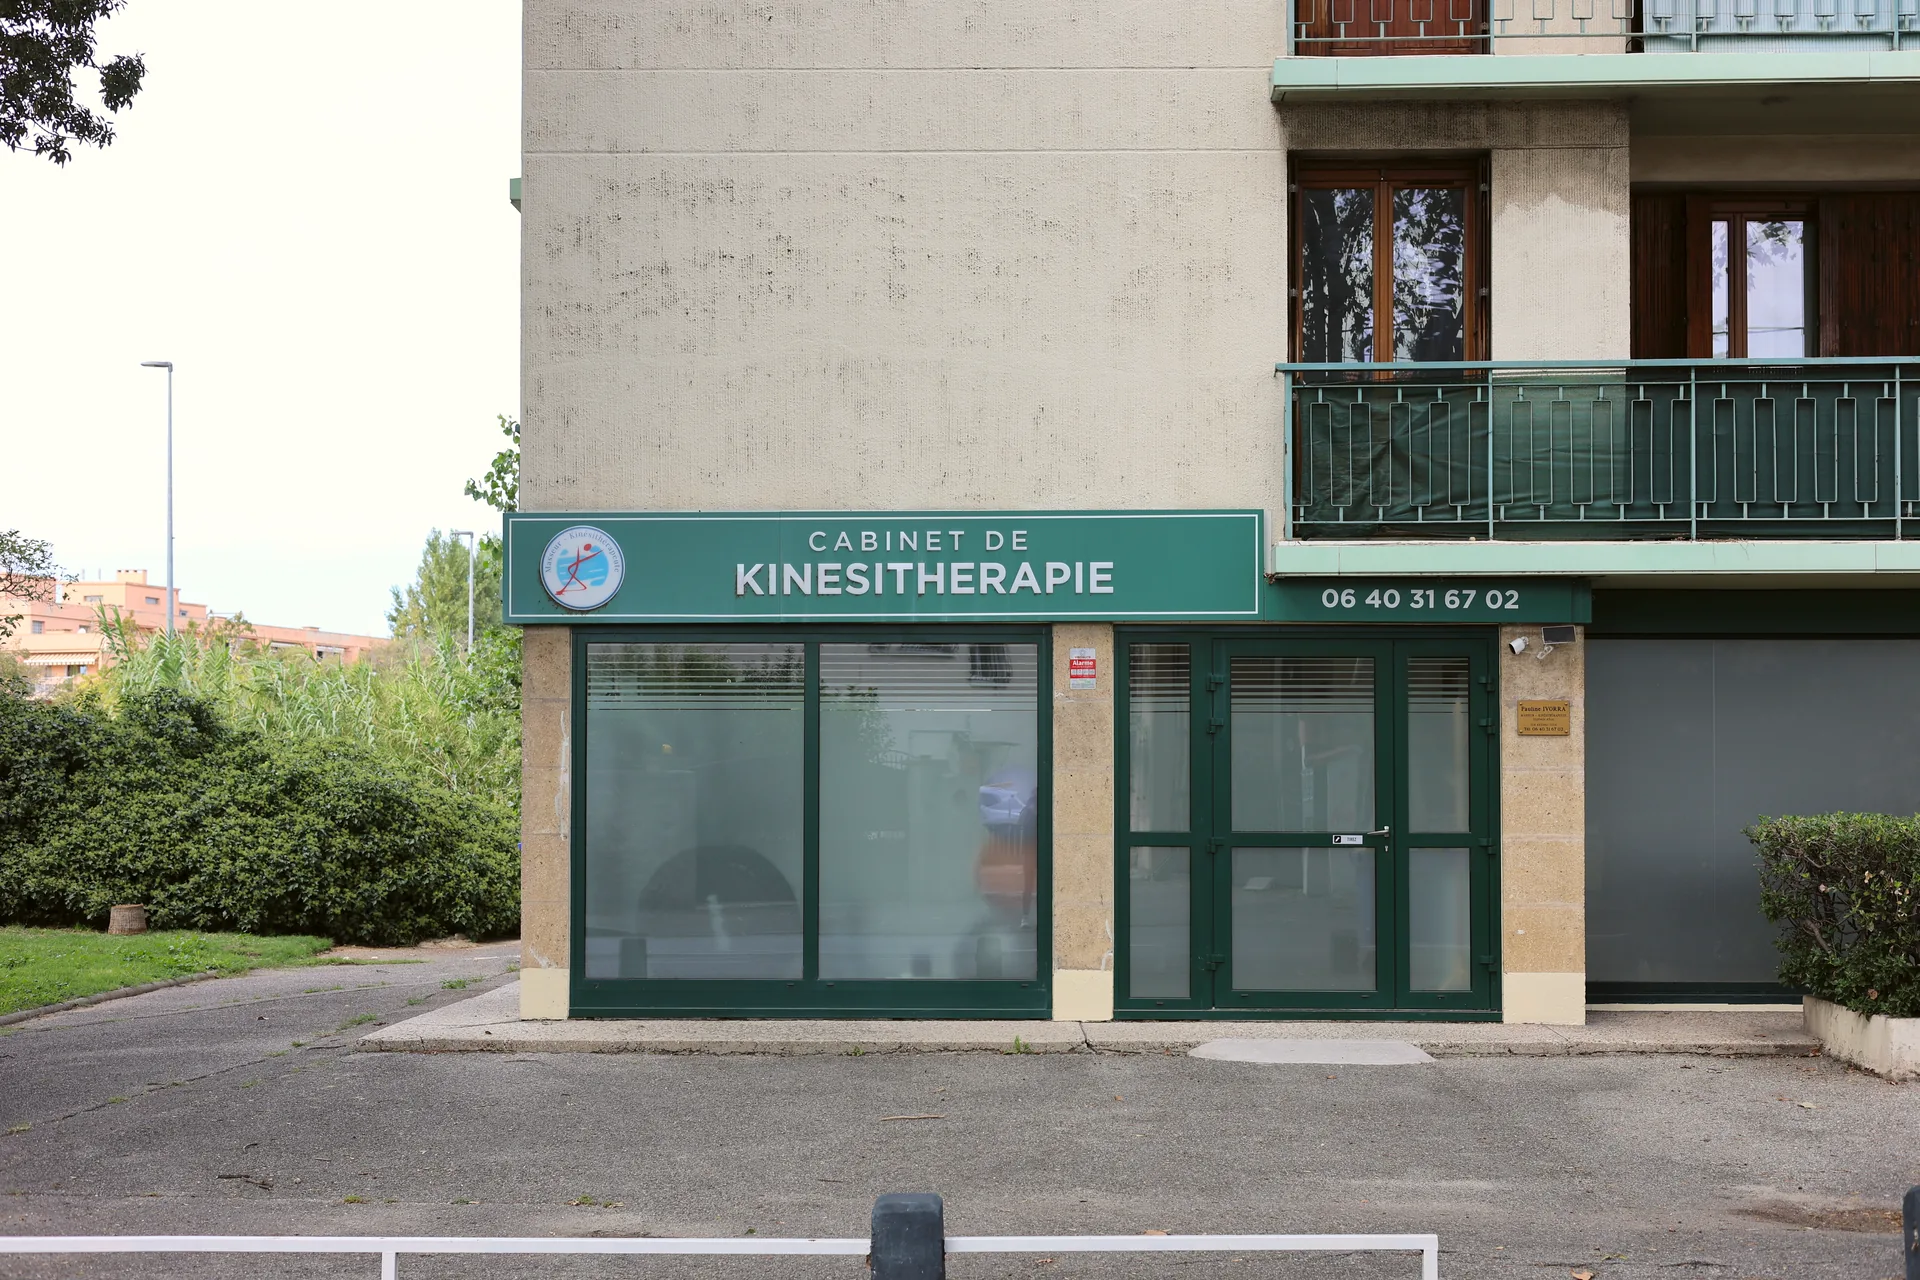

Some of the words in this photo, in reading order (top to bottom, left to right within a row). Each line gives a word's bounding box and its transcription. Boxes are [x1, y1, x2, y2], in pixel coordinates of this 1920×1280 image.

[545, 540, 562, 573] Masseur
[568, 530, 620, 573] Kinésithérapeute
[808, 530, 965, 552] CABINET
[985, 530, 1029, 551] DE
[735, 561, 1115, 596] KINESITHERAPIE
[1321, 588, 1357, 609] 06
[1364, 588, 1401, 609] 40
[1409, 589, 1435, 609] 31
[1444, 589, 1477, 609] 67
[1485, 589, 1520, 610] 02
